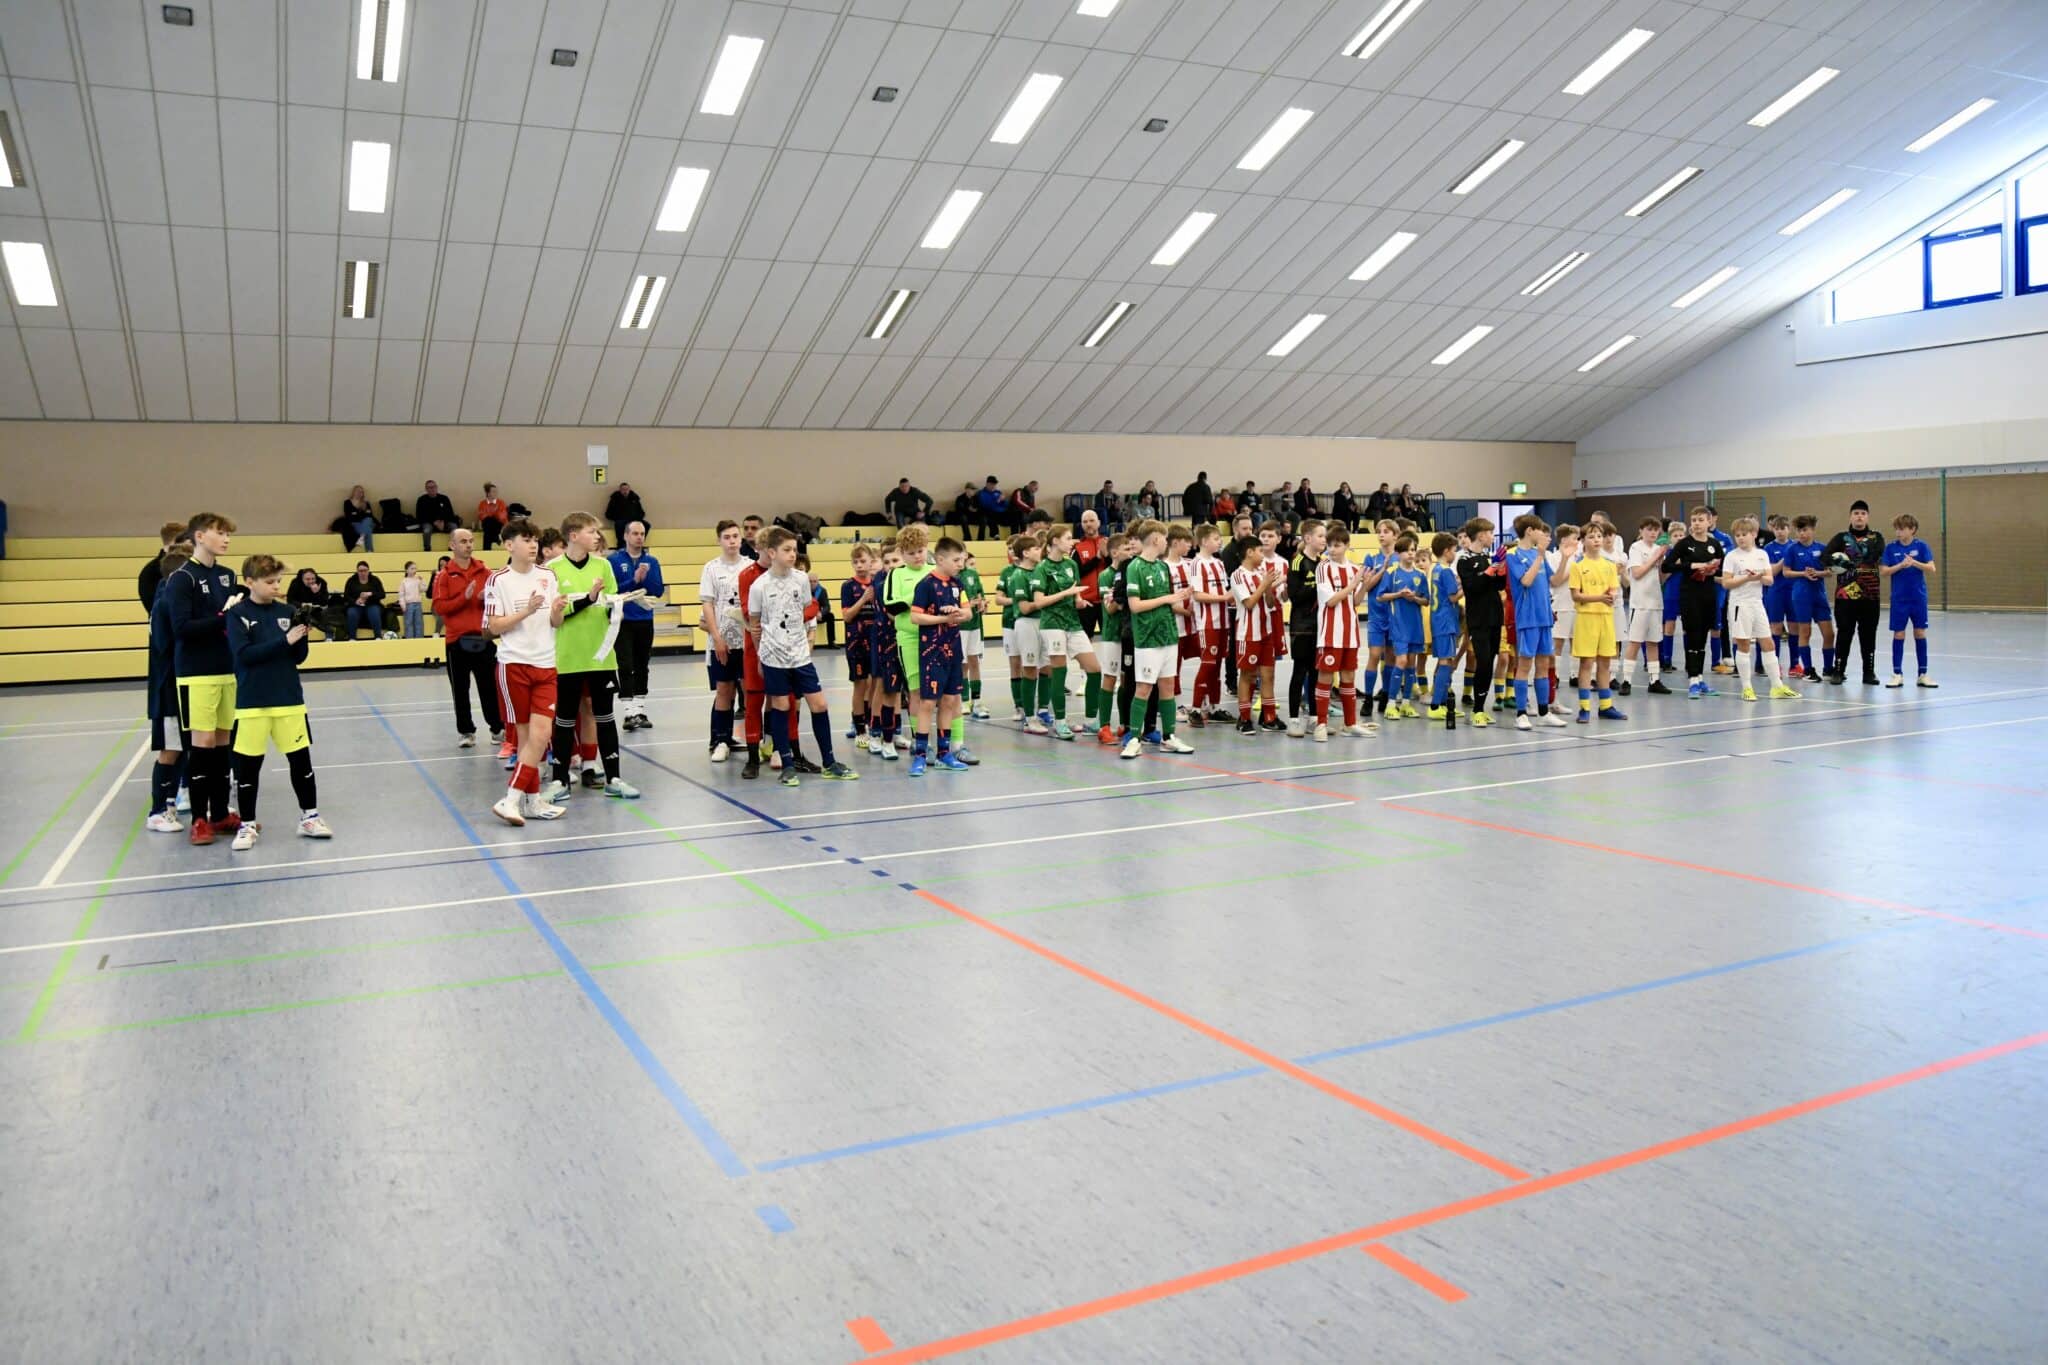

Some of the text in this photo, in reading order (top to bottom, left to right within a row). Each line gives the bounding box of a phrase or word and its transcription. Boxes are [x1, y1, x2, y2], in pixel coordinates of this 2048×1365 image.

[595, 468, 603, 482] F
[891, 674, 897, 687] 7
[930, 680, 938, 695] 9
